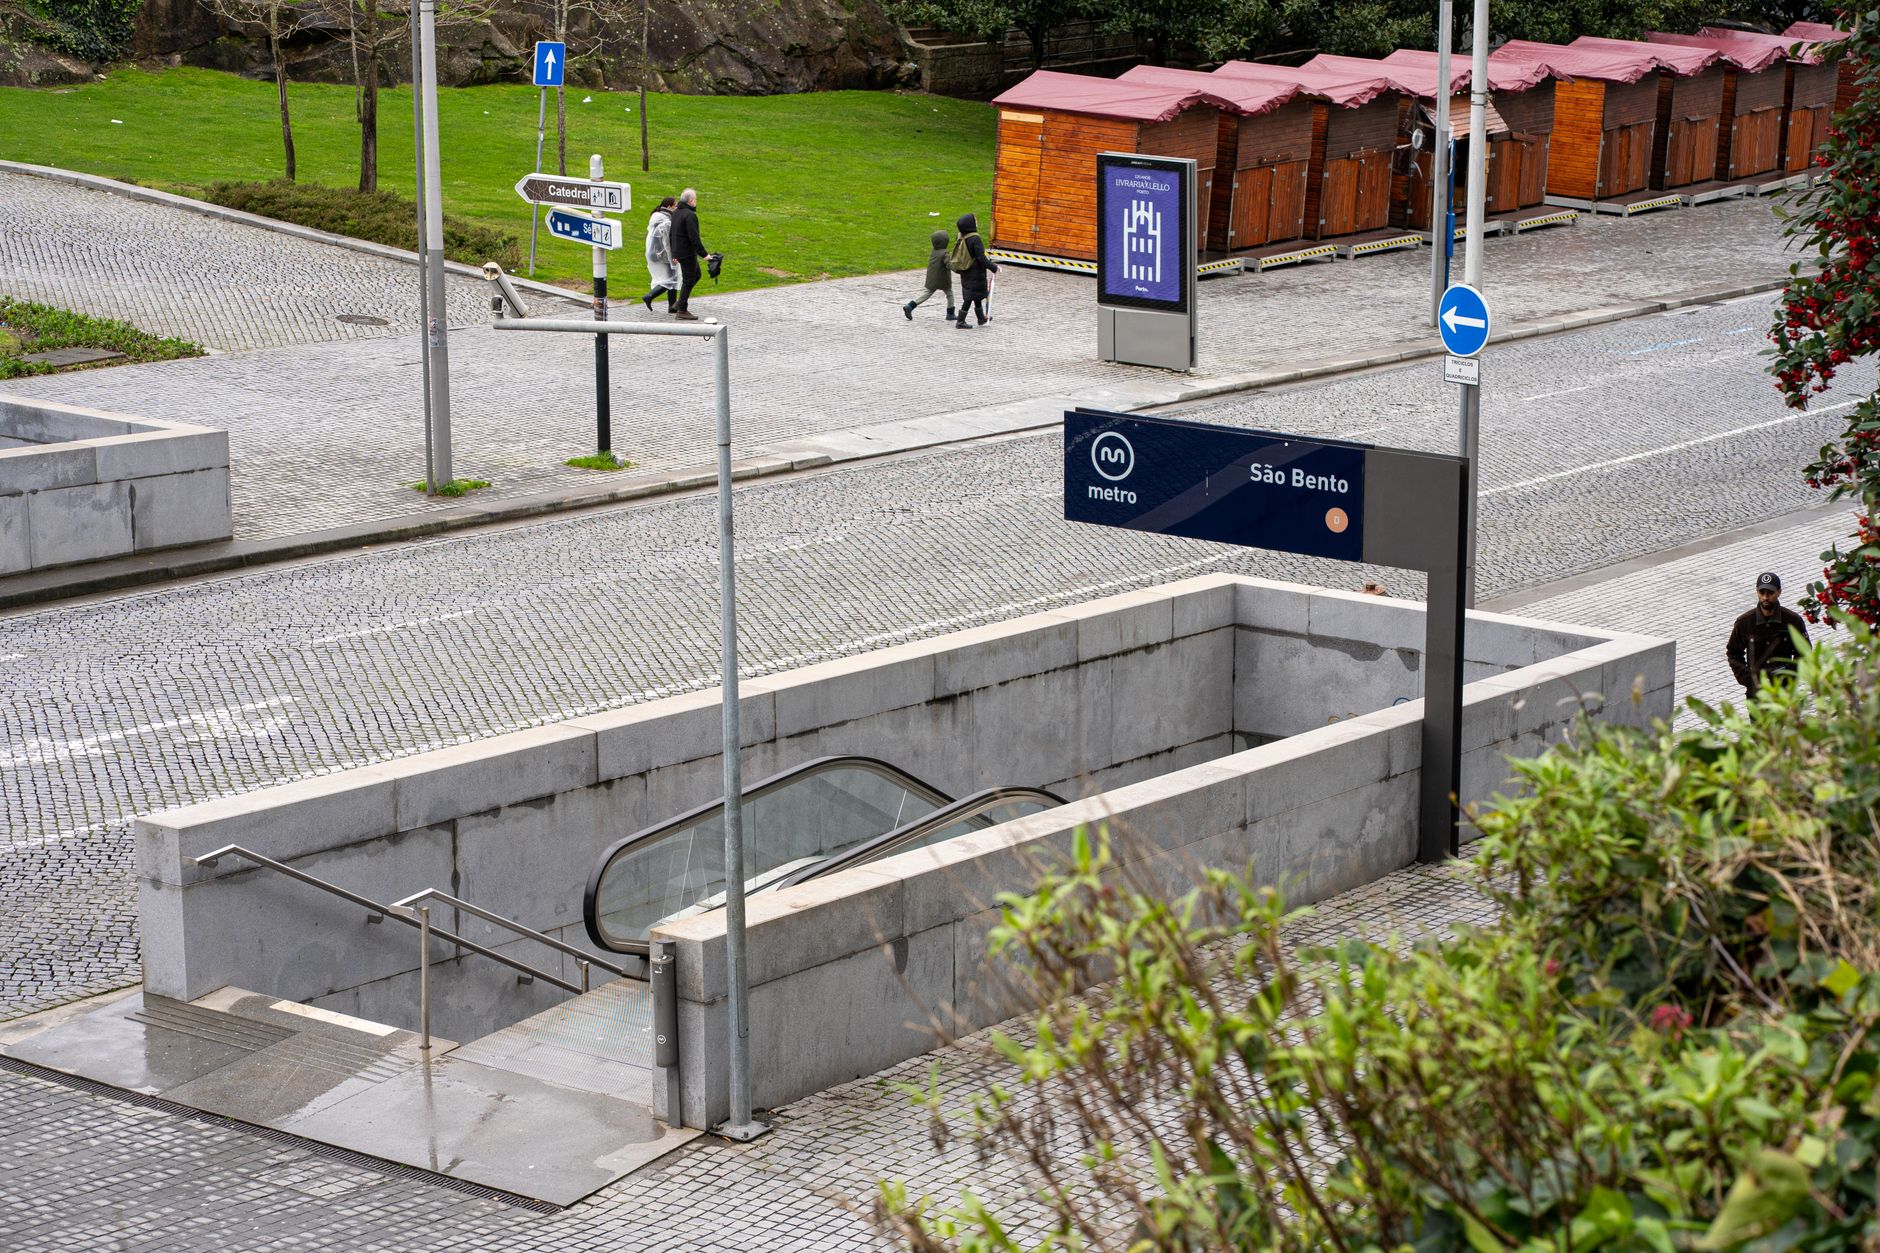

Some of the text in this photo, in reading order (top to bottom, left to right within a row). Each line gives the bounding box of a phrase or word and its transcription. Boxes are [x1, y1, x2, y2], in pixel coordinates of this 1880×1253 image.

[1116, 178, 1170, 191] LIVRARIA LELLO
[548, 184, 590, 200] Catedral
[583, 222, 592, 235] Sé
[1446, 373, 1477, 382] QUADRICICLOS
[1250, 462, 1349, 494] São Bento
[1088, 485, 1137, 504] metro
